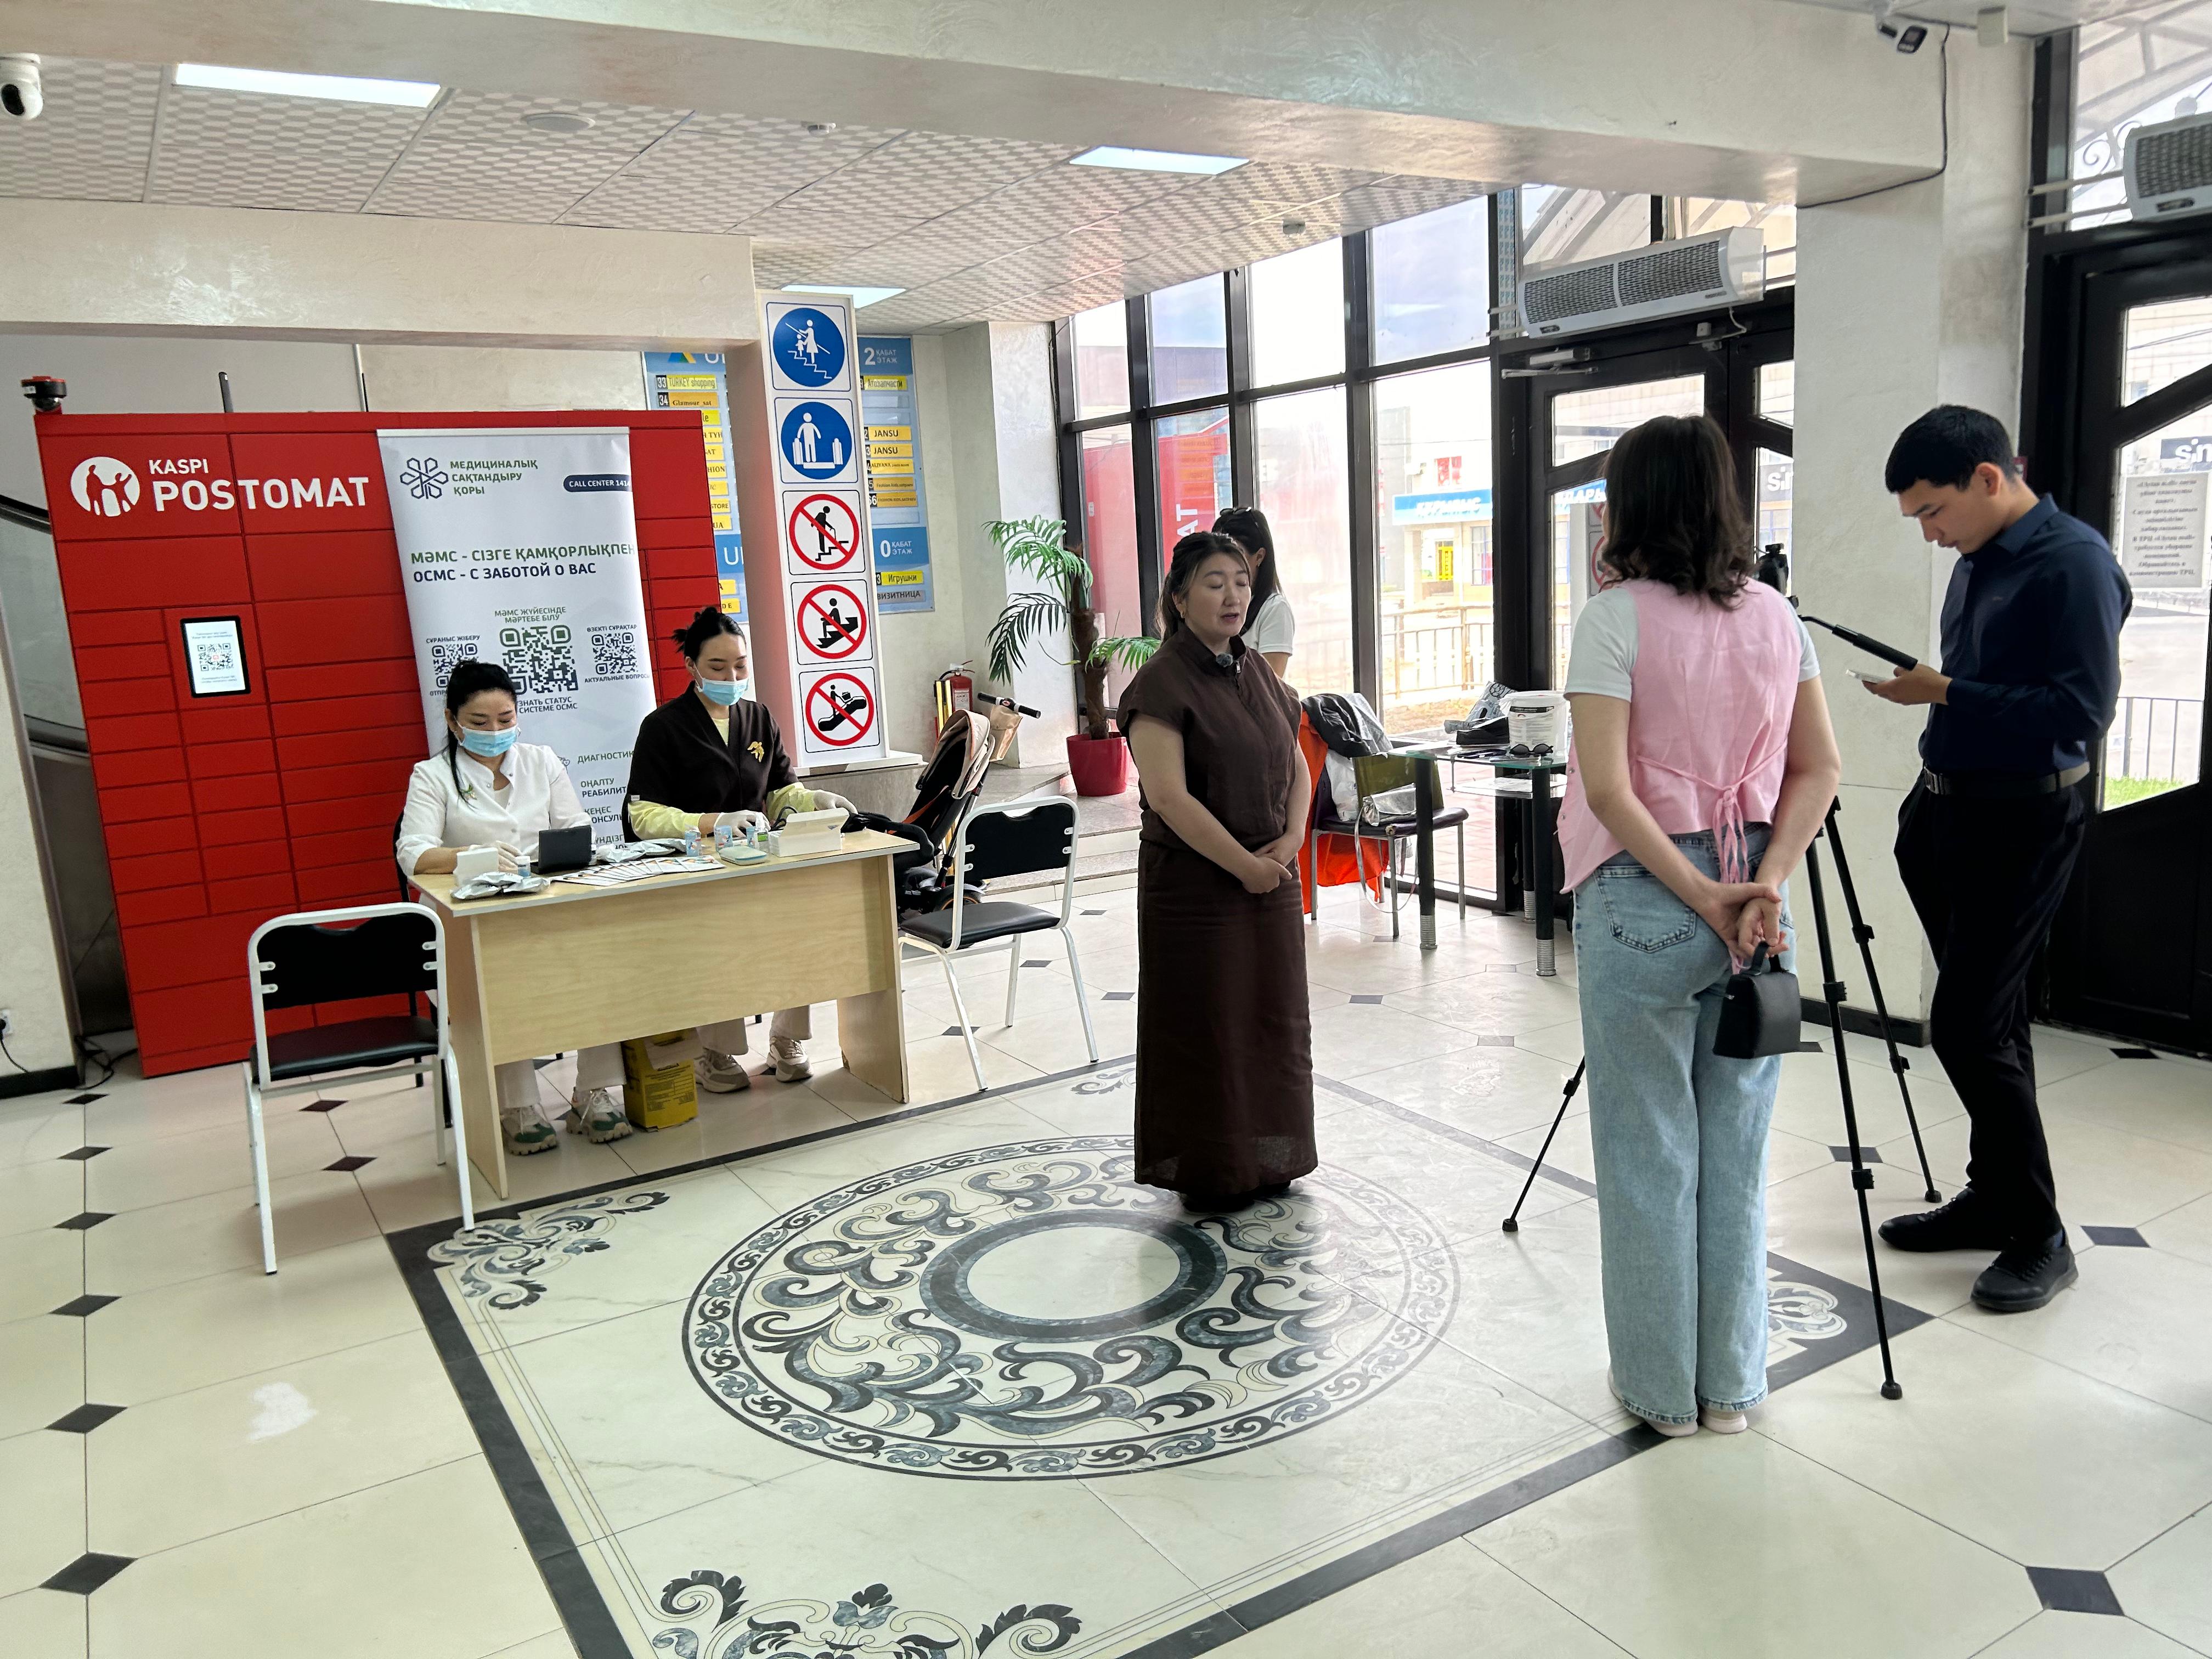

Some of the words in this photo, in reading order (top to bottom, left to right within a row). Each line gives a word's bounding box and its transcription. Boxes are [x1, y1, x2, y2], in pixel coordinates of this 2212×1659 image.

[865, 347, 876, 365] 2
[657, 377, 666, 388] 33
[669, 377, 689, 387] TURKEY
[691, 378, 715, 388] shopping
[659, 395, 668, 405] 34
[149, 459, 208, 475] KASPI
[450, 460, 538, 470] МЕДИЦИНАЛЫҚ
[452, 473, 521, 483] САҚТАНДЫРУ
[153, 477, 369, 511] POSTOMAT
[454, 486, 485, 496] ҚОРЫ
[880, 540, 891, 557] 0
[411, 550, 458, 564] МӘМС
[472, 549, 511, 561] СІЗГЕ
[516, 544, 635, 561] ҚАМҚОРЛЫҚПЕН
[414, 569, 456, 583] ОСМС
[470, 567, 478, 579] С
[483, 562, 550, 579] ЗАБОТОЙ
[555, 565, 564, 576] О
[569, 563, 596, 575] ВАС
[888, 574, 917, 584] Игрушки
[521, 607, 566, 615] ЖҮЙЕСІНДЕ
[584, 675, 624, 684] АКТУАЛЬНЫЕ
[519, 704, 554, 713] СИСТЕМЕ
[577, 751, 634, 764] ДИАГНОСТИК
[581, 778, 614, 788] ОҢАЛТУ
[582, 786, 627, 798] РЕАБИЛИТ
